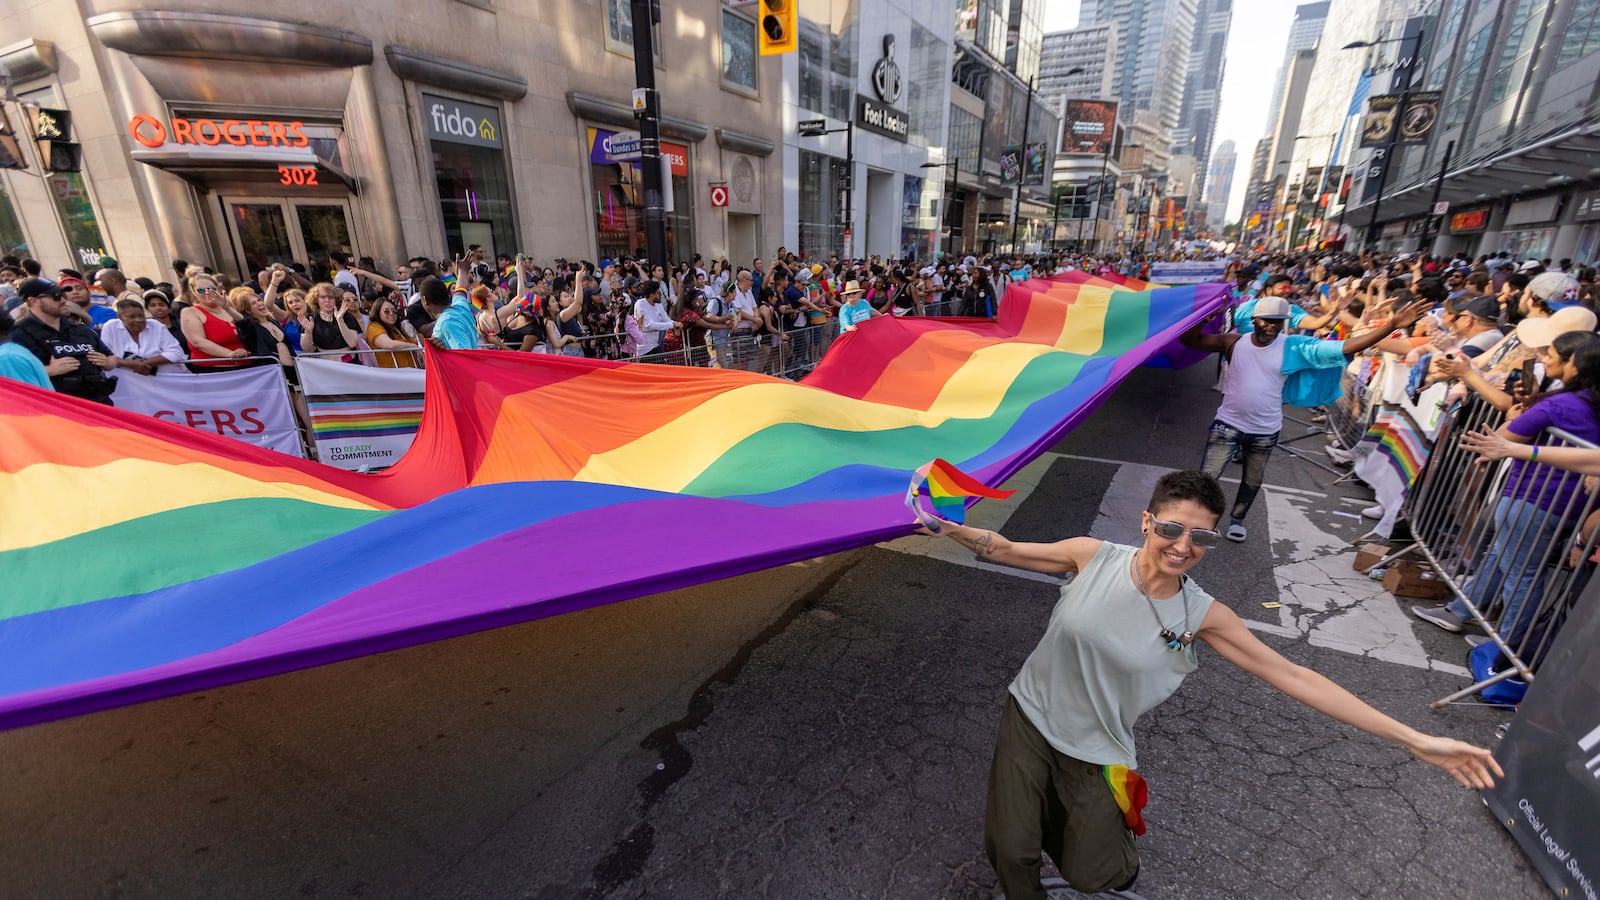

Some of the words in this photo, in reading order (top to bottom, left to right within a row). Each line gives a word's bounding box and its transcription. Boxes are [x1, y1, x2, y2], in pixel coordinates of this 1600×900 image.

[431, 104, 477, 137] fido
[864, 102, 883, 127] Foot
[884, 110, 907, 135] Locker
[171, 118, 309, 148] ROGERS
[612, 143, 631, 154] Dundas
[277, 167, 319, 186] 302
[55, 344, 95, 354] POLICE
[331, 450, 393, 460] COMMITMENT
[343, 444, 372, 452] READY
[1518, 798, 1544, 832] Official
[1539, 828, 1570, 861] Legal
